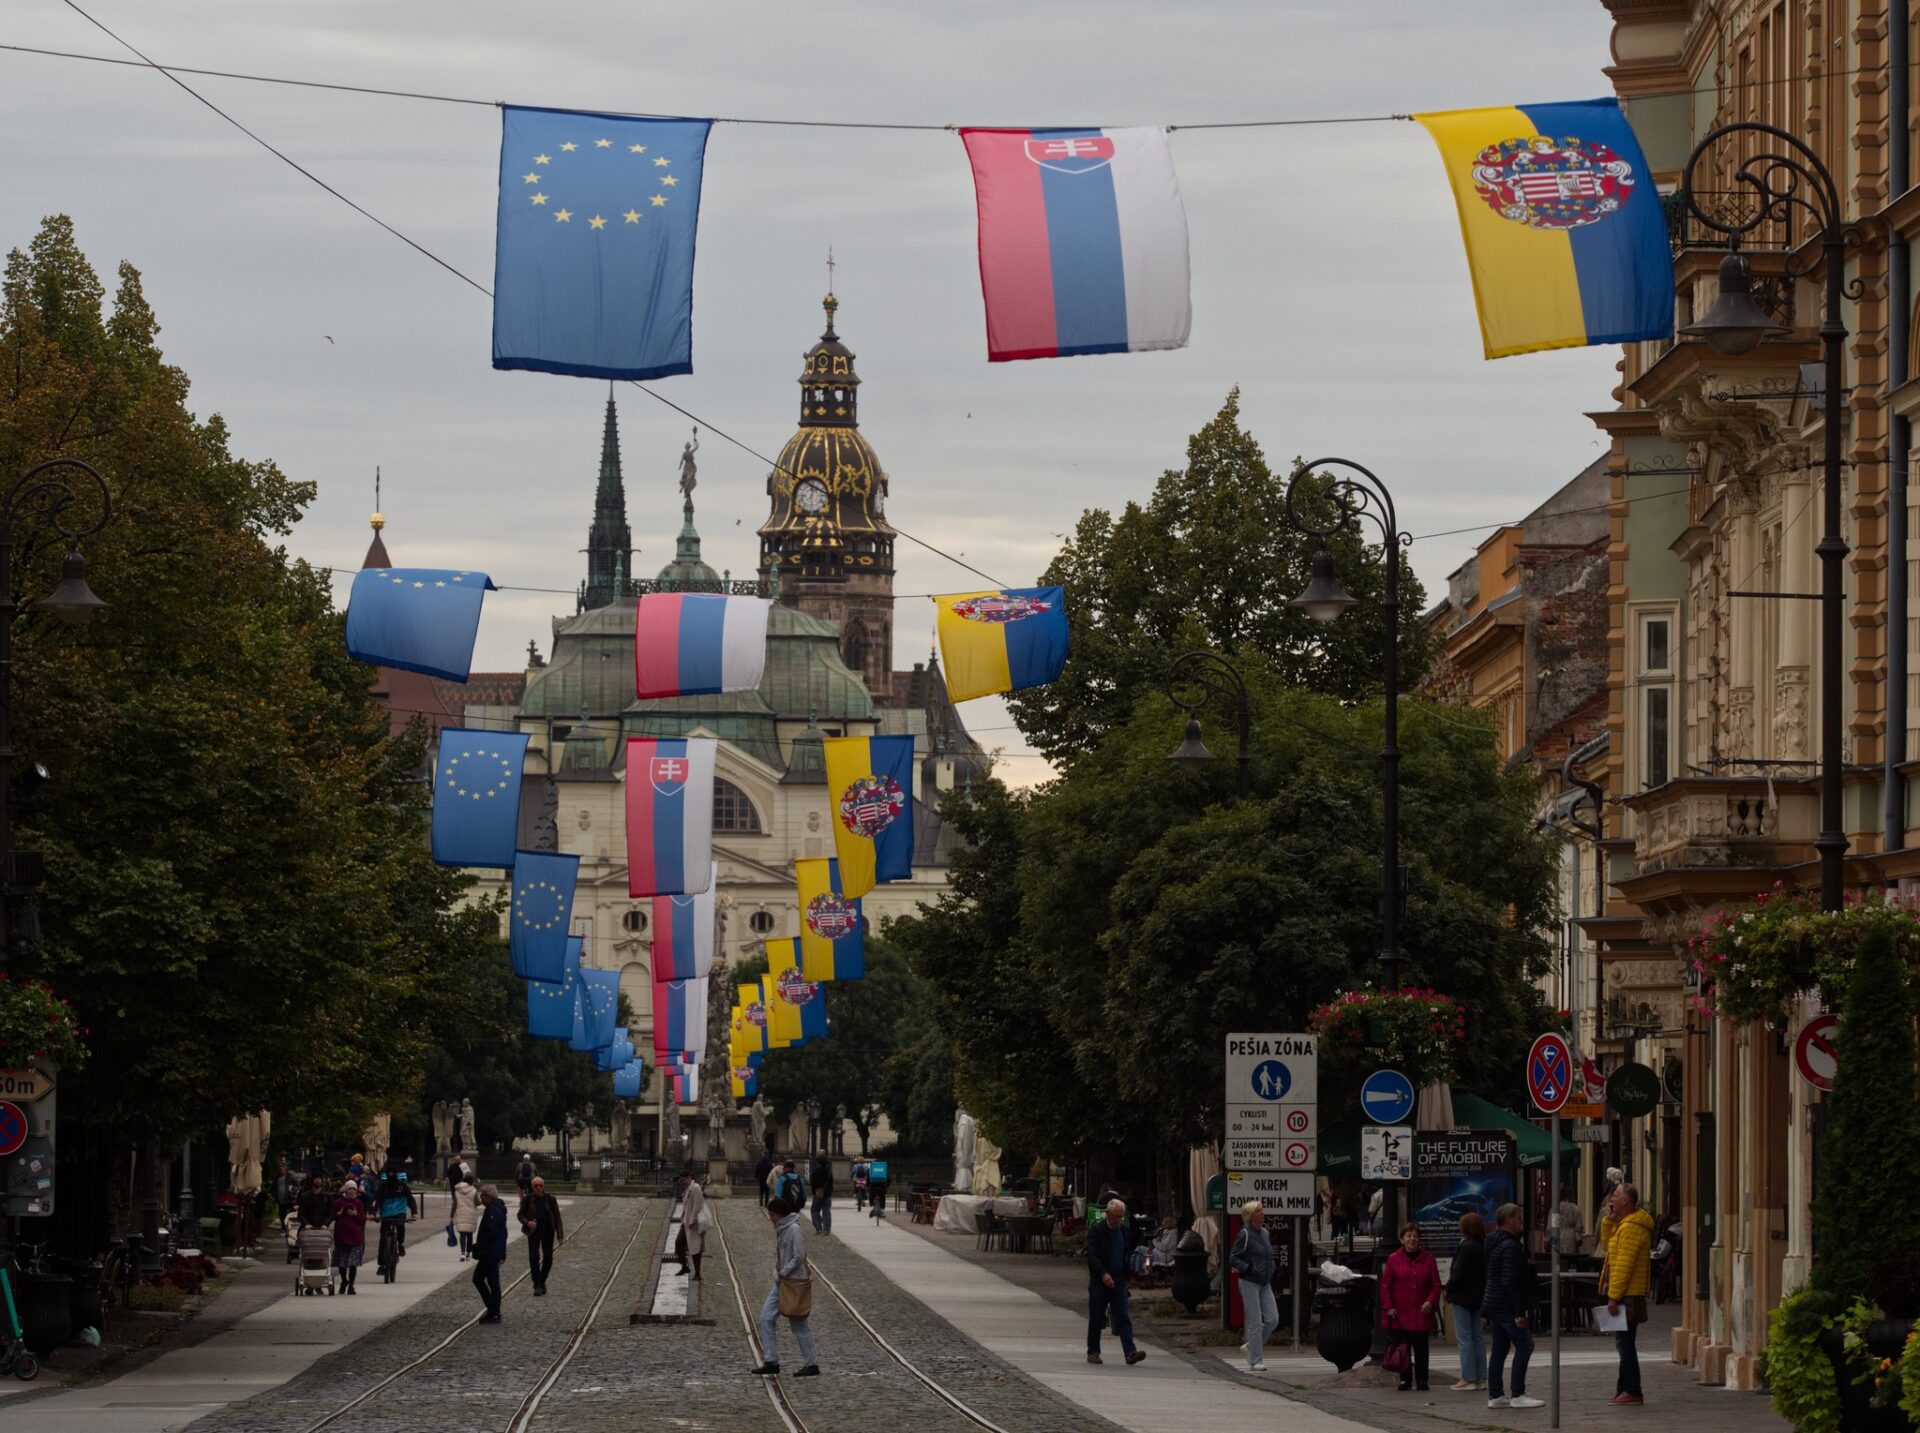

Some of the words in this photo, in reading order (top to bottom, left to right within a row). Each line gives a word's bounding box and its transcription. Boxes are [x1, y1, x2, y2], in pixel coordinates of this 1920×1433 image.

[1230, 1037, 1270, 1055] PEŠIA
[1274, 1037, 1313, 1055] ZÓNA
[1262, 1123, 1276, 1131] hod.
[1292, 1117, 1304, 1127] 10
[1232, 1141, 1275, 1149] ZÁSOBOVANIE
[1417, 1141, 1447, 1153] THE
[1449, 1140, 1508, 1153] FUTURE
[1417, 1153, 1439, 1165] OF
[1440, 1152, 1508, 1164] MOBILITY
[1254, 1179, 1288, 1191] OKREM
[1287, 1197, 1311, 1208] MMK
[1280, 1244, 1289, 1268] 2024
